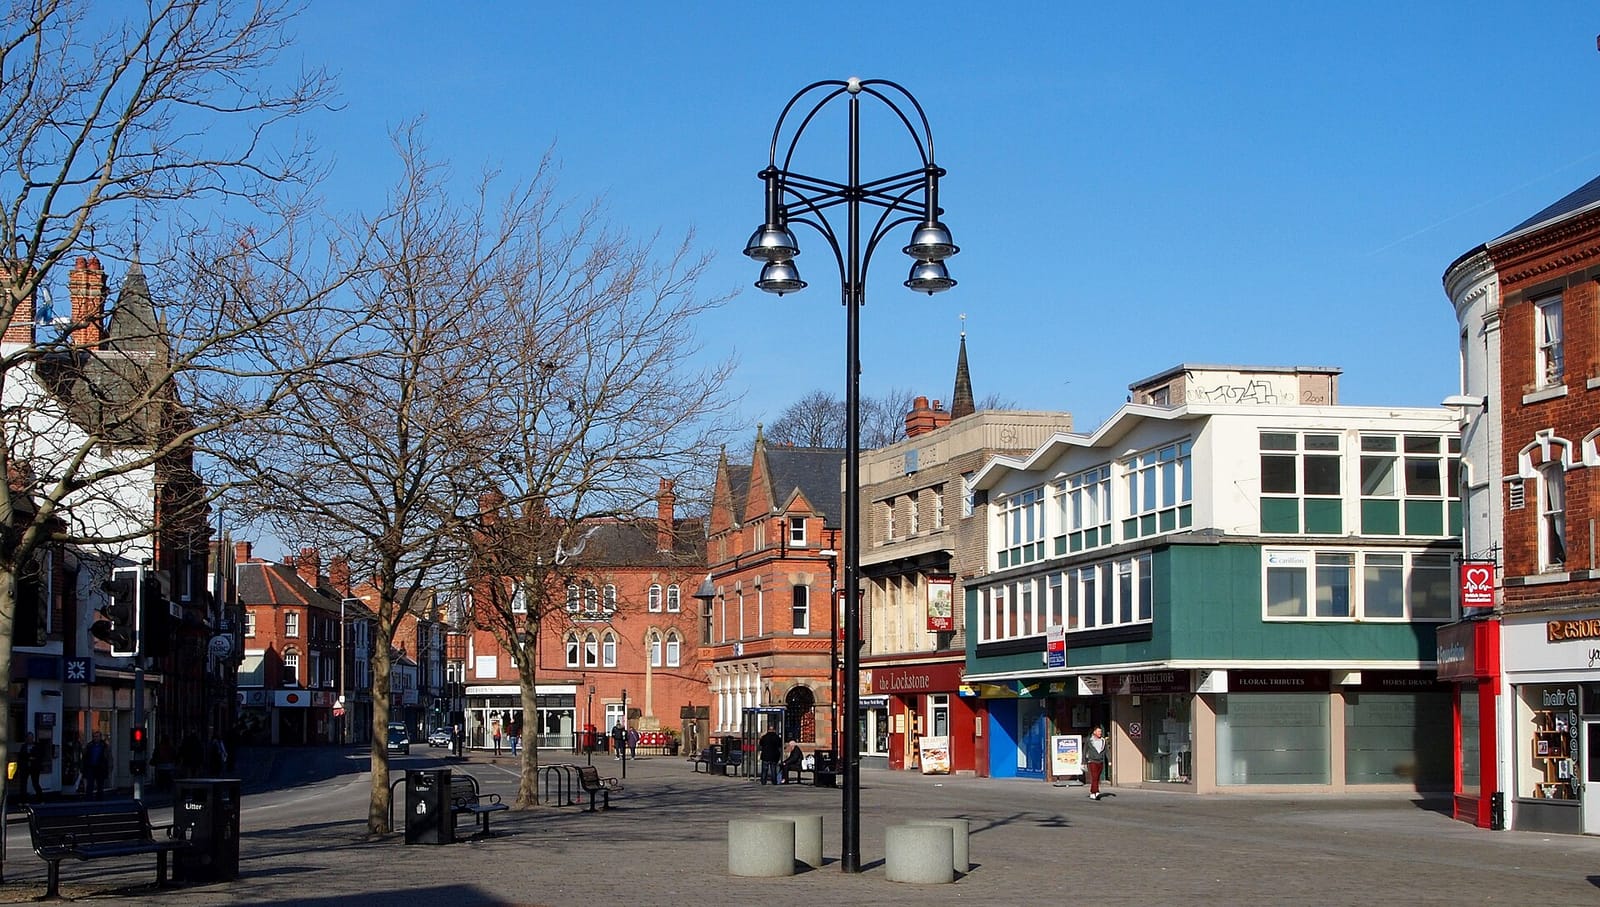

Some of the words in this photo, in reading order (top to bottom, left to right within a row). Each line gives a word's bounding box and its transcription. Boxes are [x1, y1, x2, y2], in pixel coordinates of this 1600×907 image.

[879, 676, 889, 690] the
[890, 671, 930, 690] Lockstone
[1239, 678, 1267, 686] FLORAL
[1270, 678, 1305, 686] TRIBUTES
[1543, 689, 1566, 706] hair
[1567, 688, 1577, 706] &
